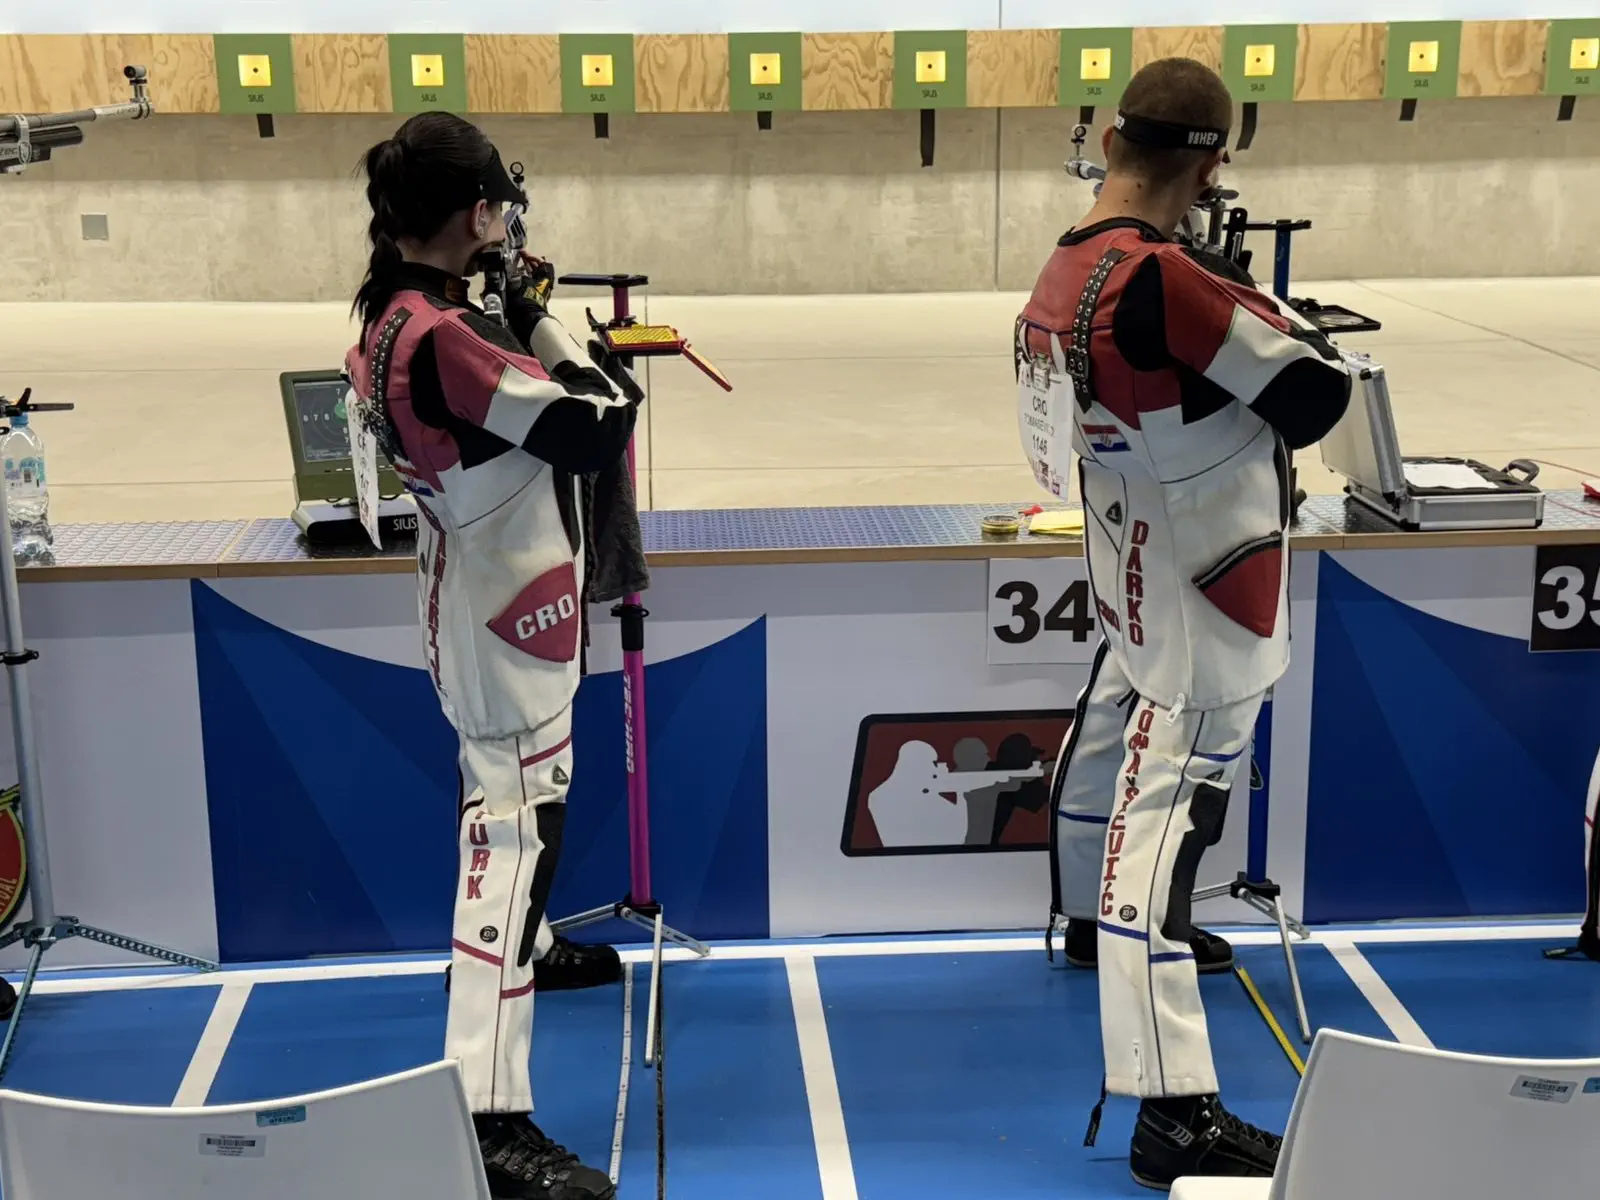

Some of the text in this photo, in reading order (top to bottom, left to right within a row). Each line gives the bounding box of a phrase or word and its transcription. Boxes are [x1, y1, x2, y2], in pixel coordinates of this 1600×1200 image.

[1032, 395, 1048, 416] CRO
[393, 517, 417, 531] SIUS
[993, 580, 1095, 644] 34
[1126, 519, 1149, 647] DARKO
[1537, 565, 1600, 630] 3
[515, 593, 575, 640] CRO
[466, 811, 491, 900] URK
